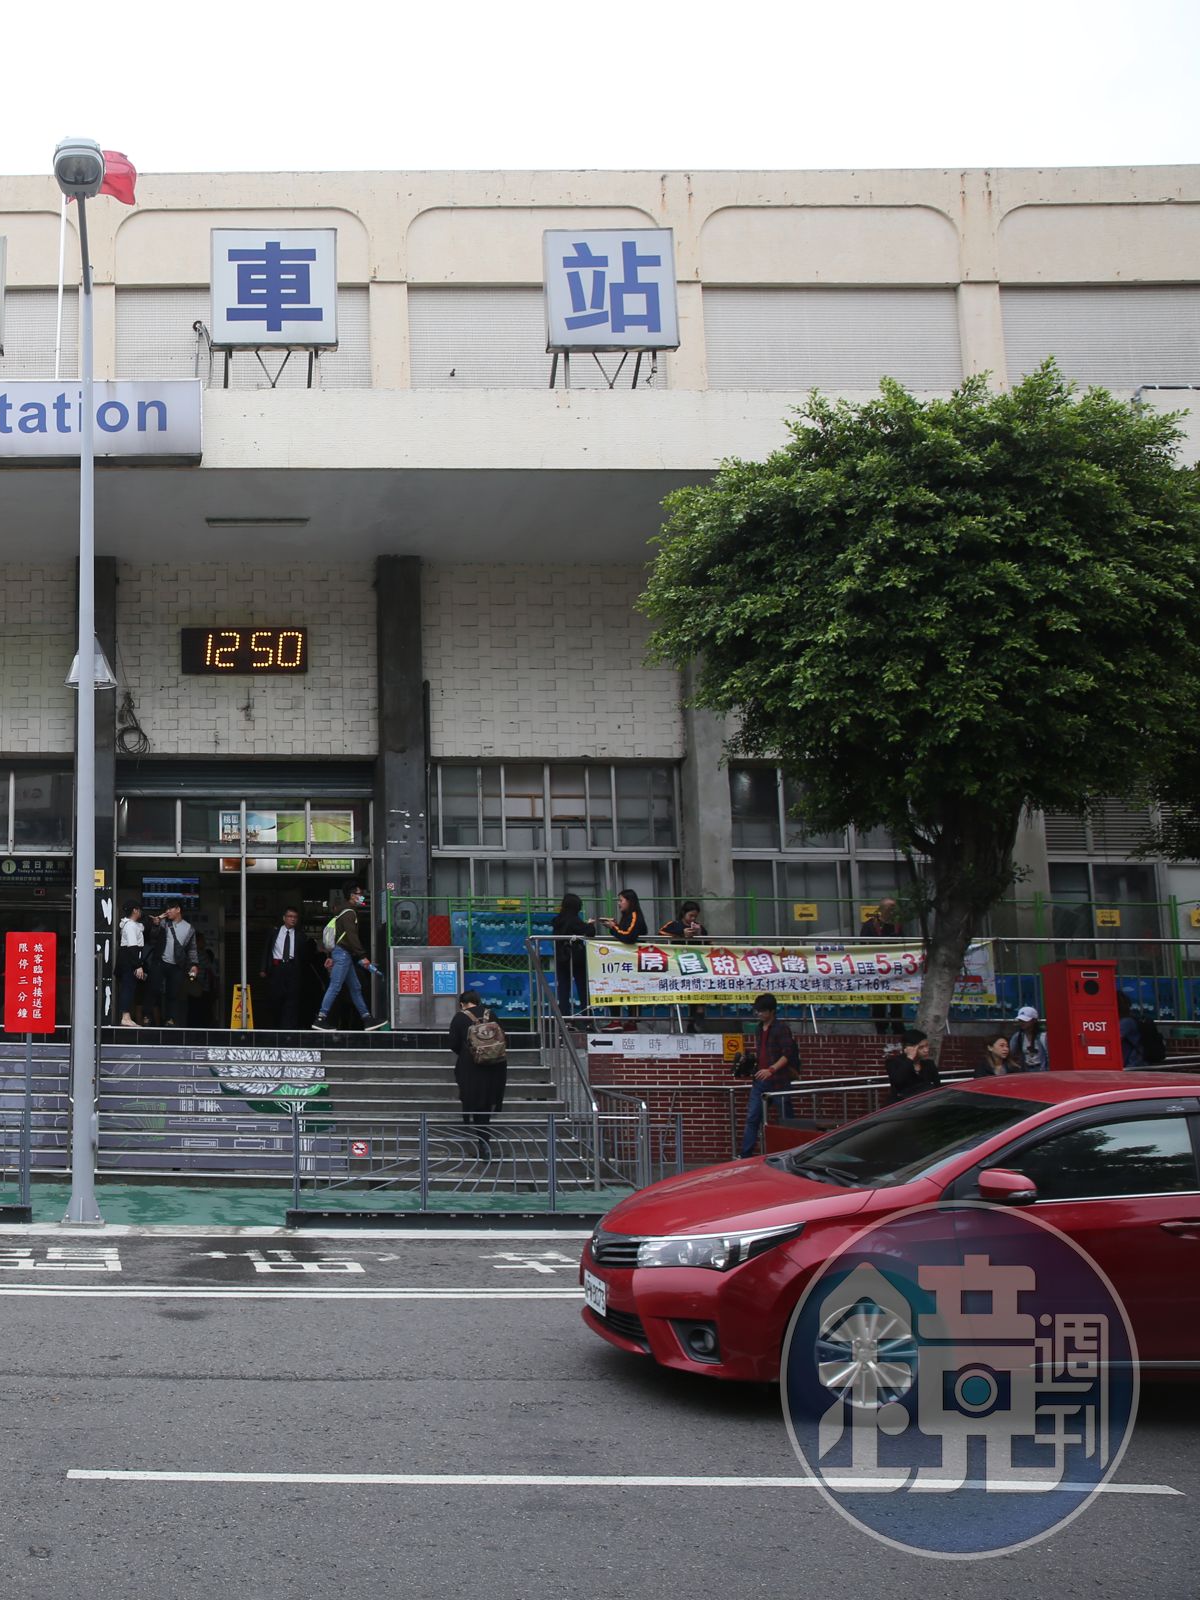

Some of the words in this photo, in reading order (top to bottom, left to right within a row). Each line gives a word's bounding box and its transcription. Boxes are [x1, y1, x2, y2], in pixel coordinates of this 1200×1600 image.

[225, 240, 324, 332] 車
[562, 240, 662, 333] 站
[17, 942, 29, 1018] 限停三分鐘
[32, 942, 44, 1019] 旅客臨時接送區
[601, 961, 633, 974] 107年
[1082, 1021, 1107, 1032] POST
